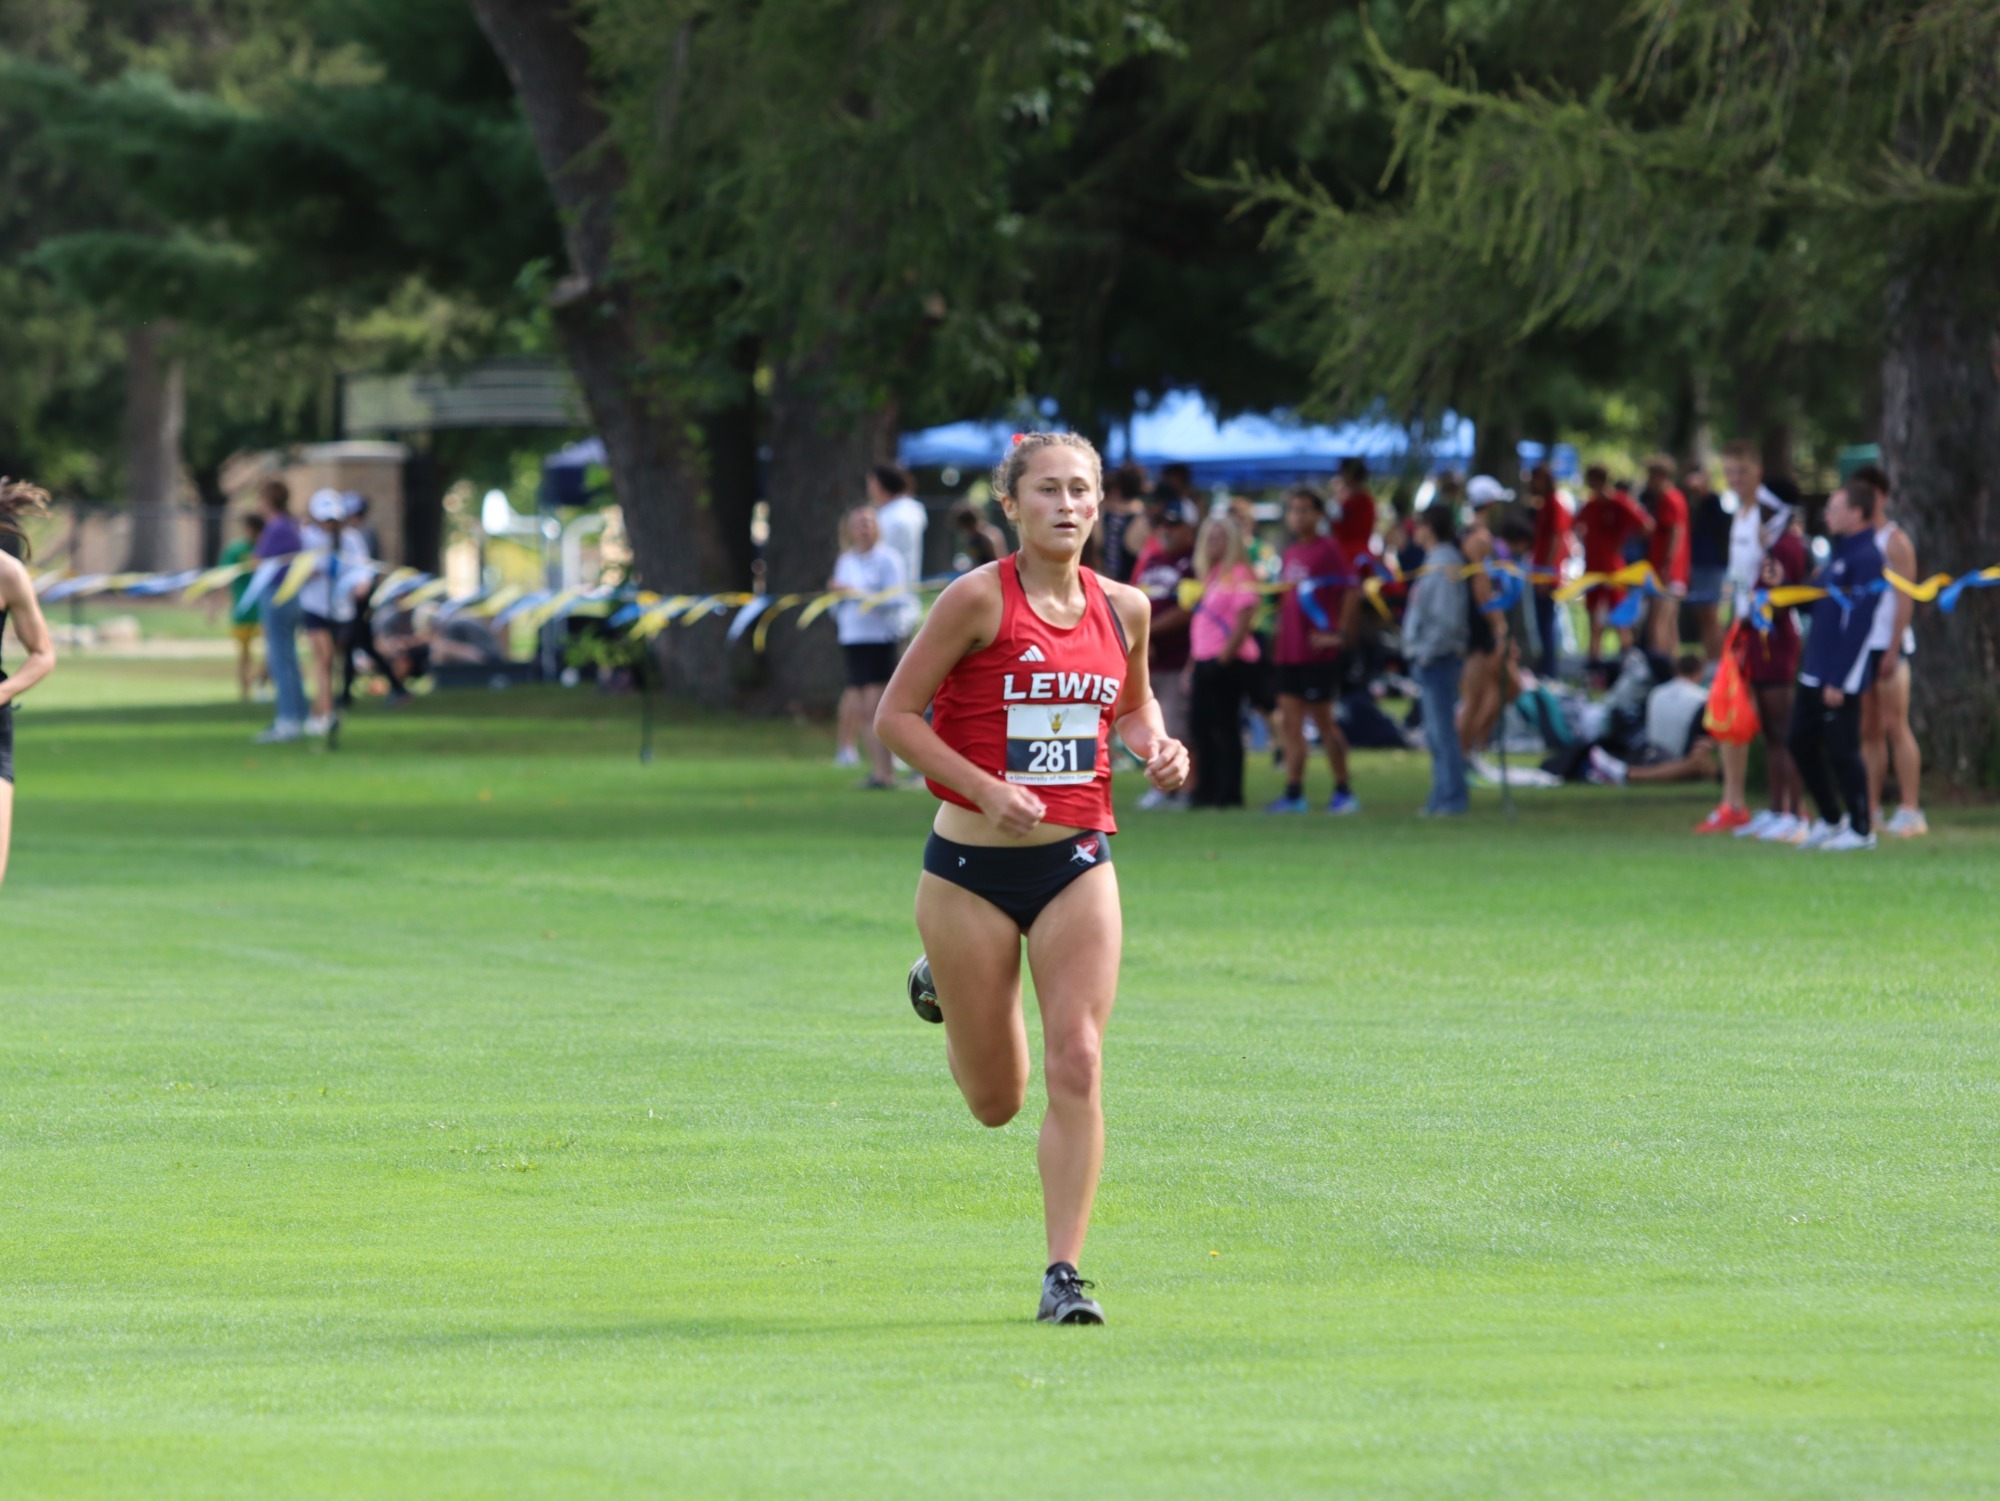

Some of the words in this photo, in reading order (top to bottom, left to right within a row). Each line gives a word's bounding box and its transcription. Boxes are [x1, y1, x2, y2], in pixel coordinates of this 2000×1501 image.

[1003, 671, 1120, 704] LEWIS
[1028, 739, 1078, 772] 281
[1014, 774, 1047, 782] University
